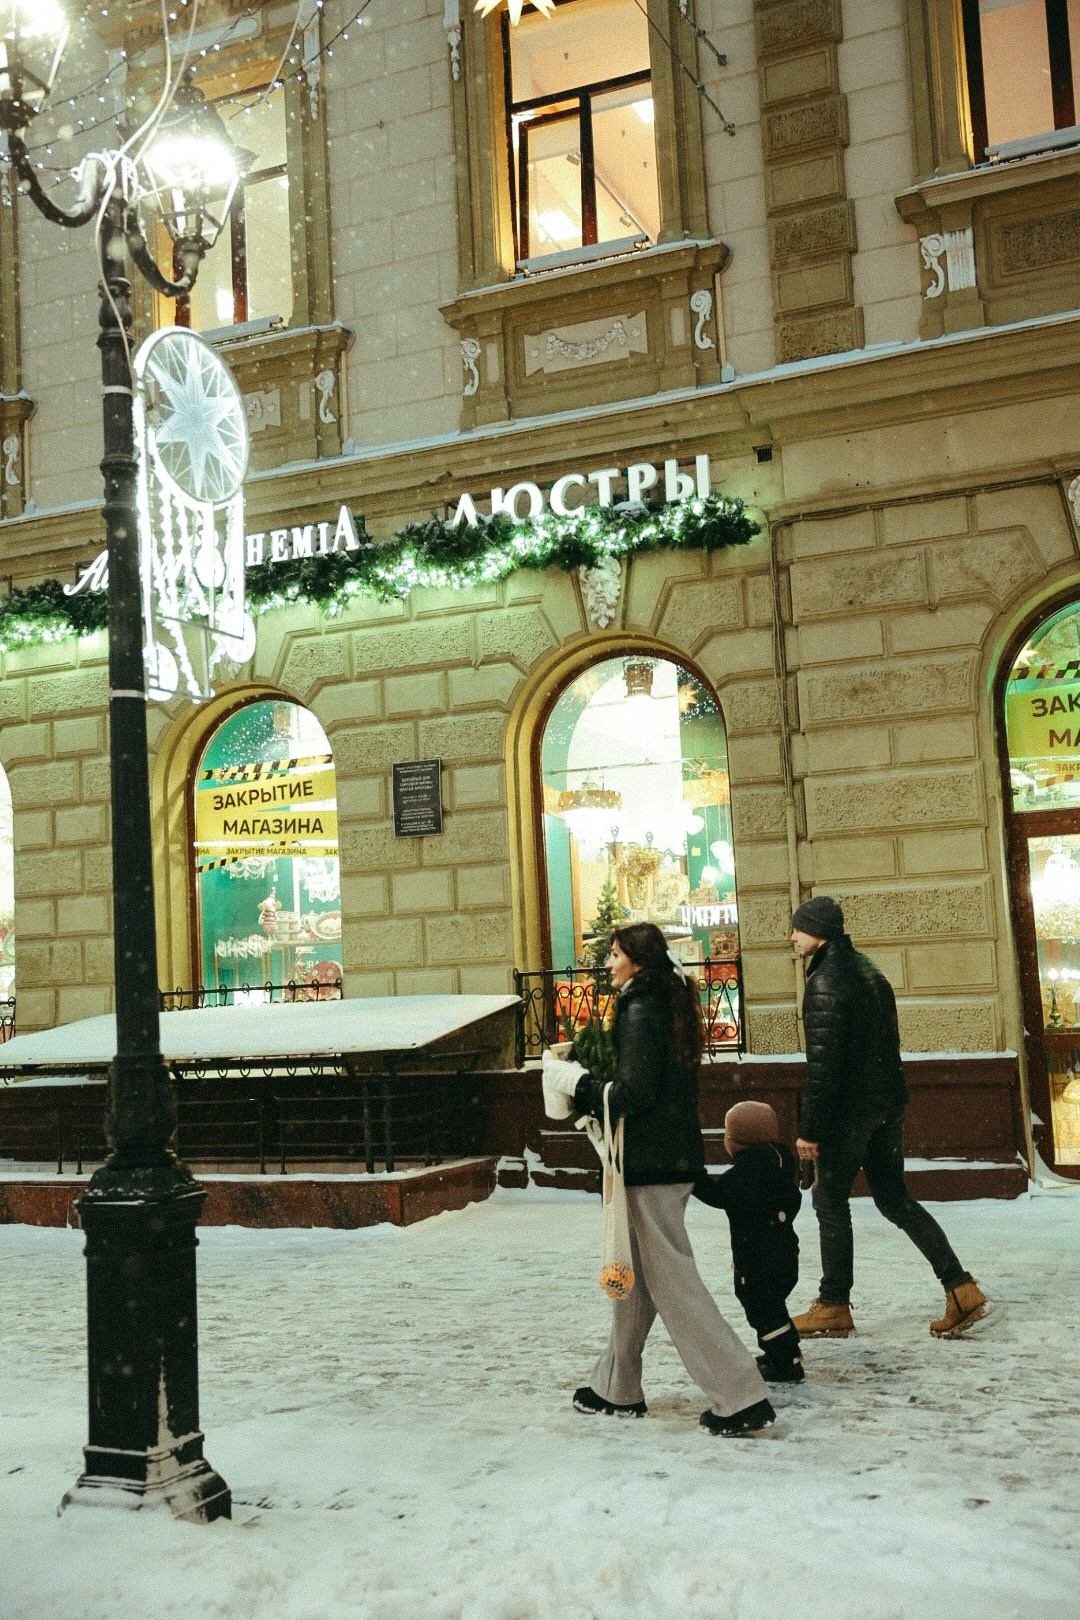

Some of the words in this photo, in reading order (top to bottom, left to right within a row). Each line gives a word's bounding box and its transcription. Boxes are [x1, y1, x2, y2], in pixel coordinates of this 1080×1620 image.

[451, 453, 711, 528] ЛЮСТРЫ
[246, 504, 360, 567] HEMIA
[1031, 692, 1080, 718] ЗАК
[213, 780, 314, 811] ЗАКРЫТИЕ
[223, 818, 324, 836] МАГАЗИНА
[226, 847, 265, 856] ЗАКРЫТИЕ
[267, 847, 307, 856] МАГАЗИНА
